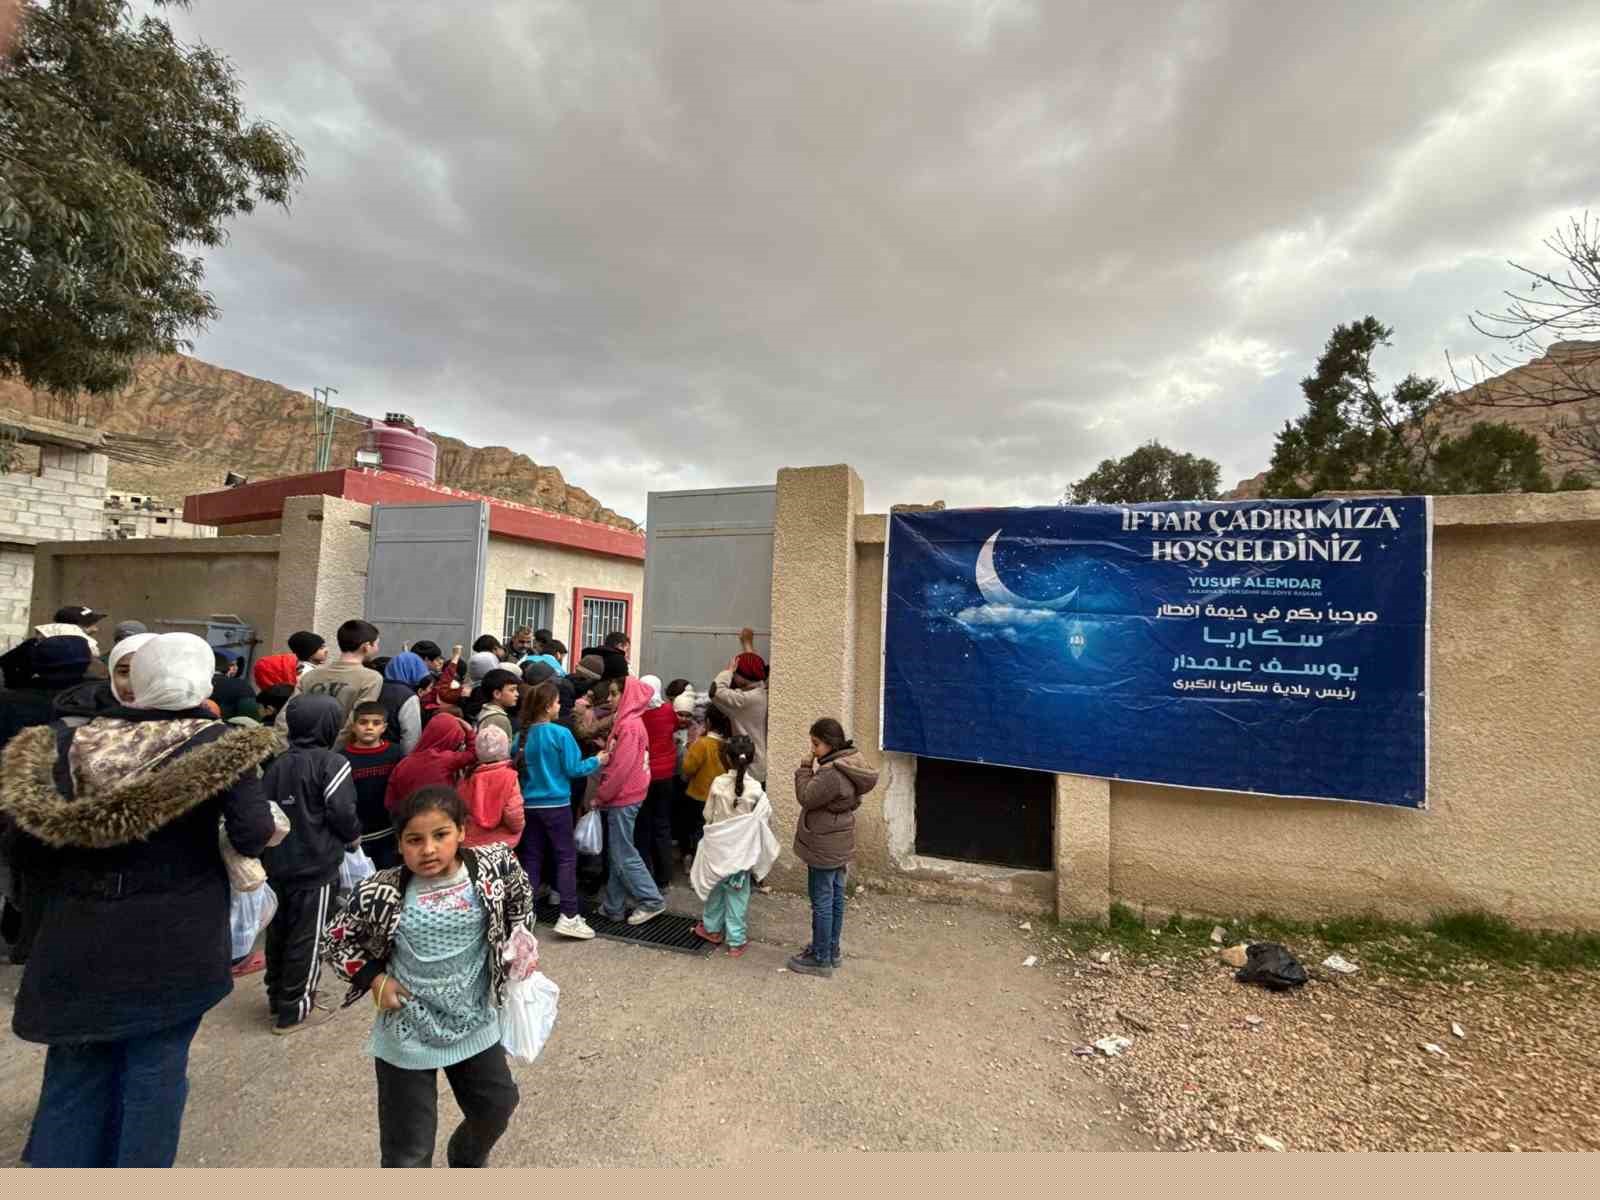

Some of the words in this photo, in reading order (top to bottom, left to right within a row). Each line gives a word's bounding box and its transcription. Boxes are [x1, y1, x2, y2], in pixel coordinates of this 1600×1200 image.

[1121, 507, 1202, 532] İFTAR
[1208, 506, 1400, 537] ÇADIRIMIZA
[1151, 532, 1362, 568] HOŞGELDİNİZ
[1188, 576, 1241, 587] YUSUF
[1244, 577, 1322, 589] ALEMDAR
[1205, 603, 1248, 621] خيمة
[1253, 606, 1281, 624] في
[1284, 607, 1323, 623] بكم
[1327, 601, 1378, 625] مرحباً
[1203, 626, 1323, 649] سكاريا
[1259, 657, 1359, 682] يوسف
[1172, 678, 1216, 690] الكبرى
[1220, 680, 1268, 693] سكاريا
[1272, 682, 1310, 699] بلدية
[1315, 685, 1356, 700] رئيس
